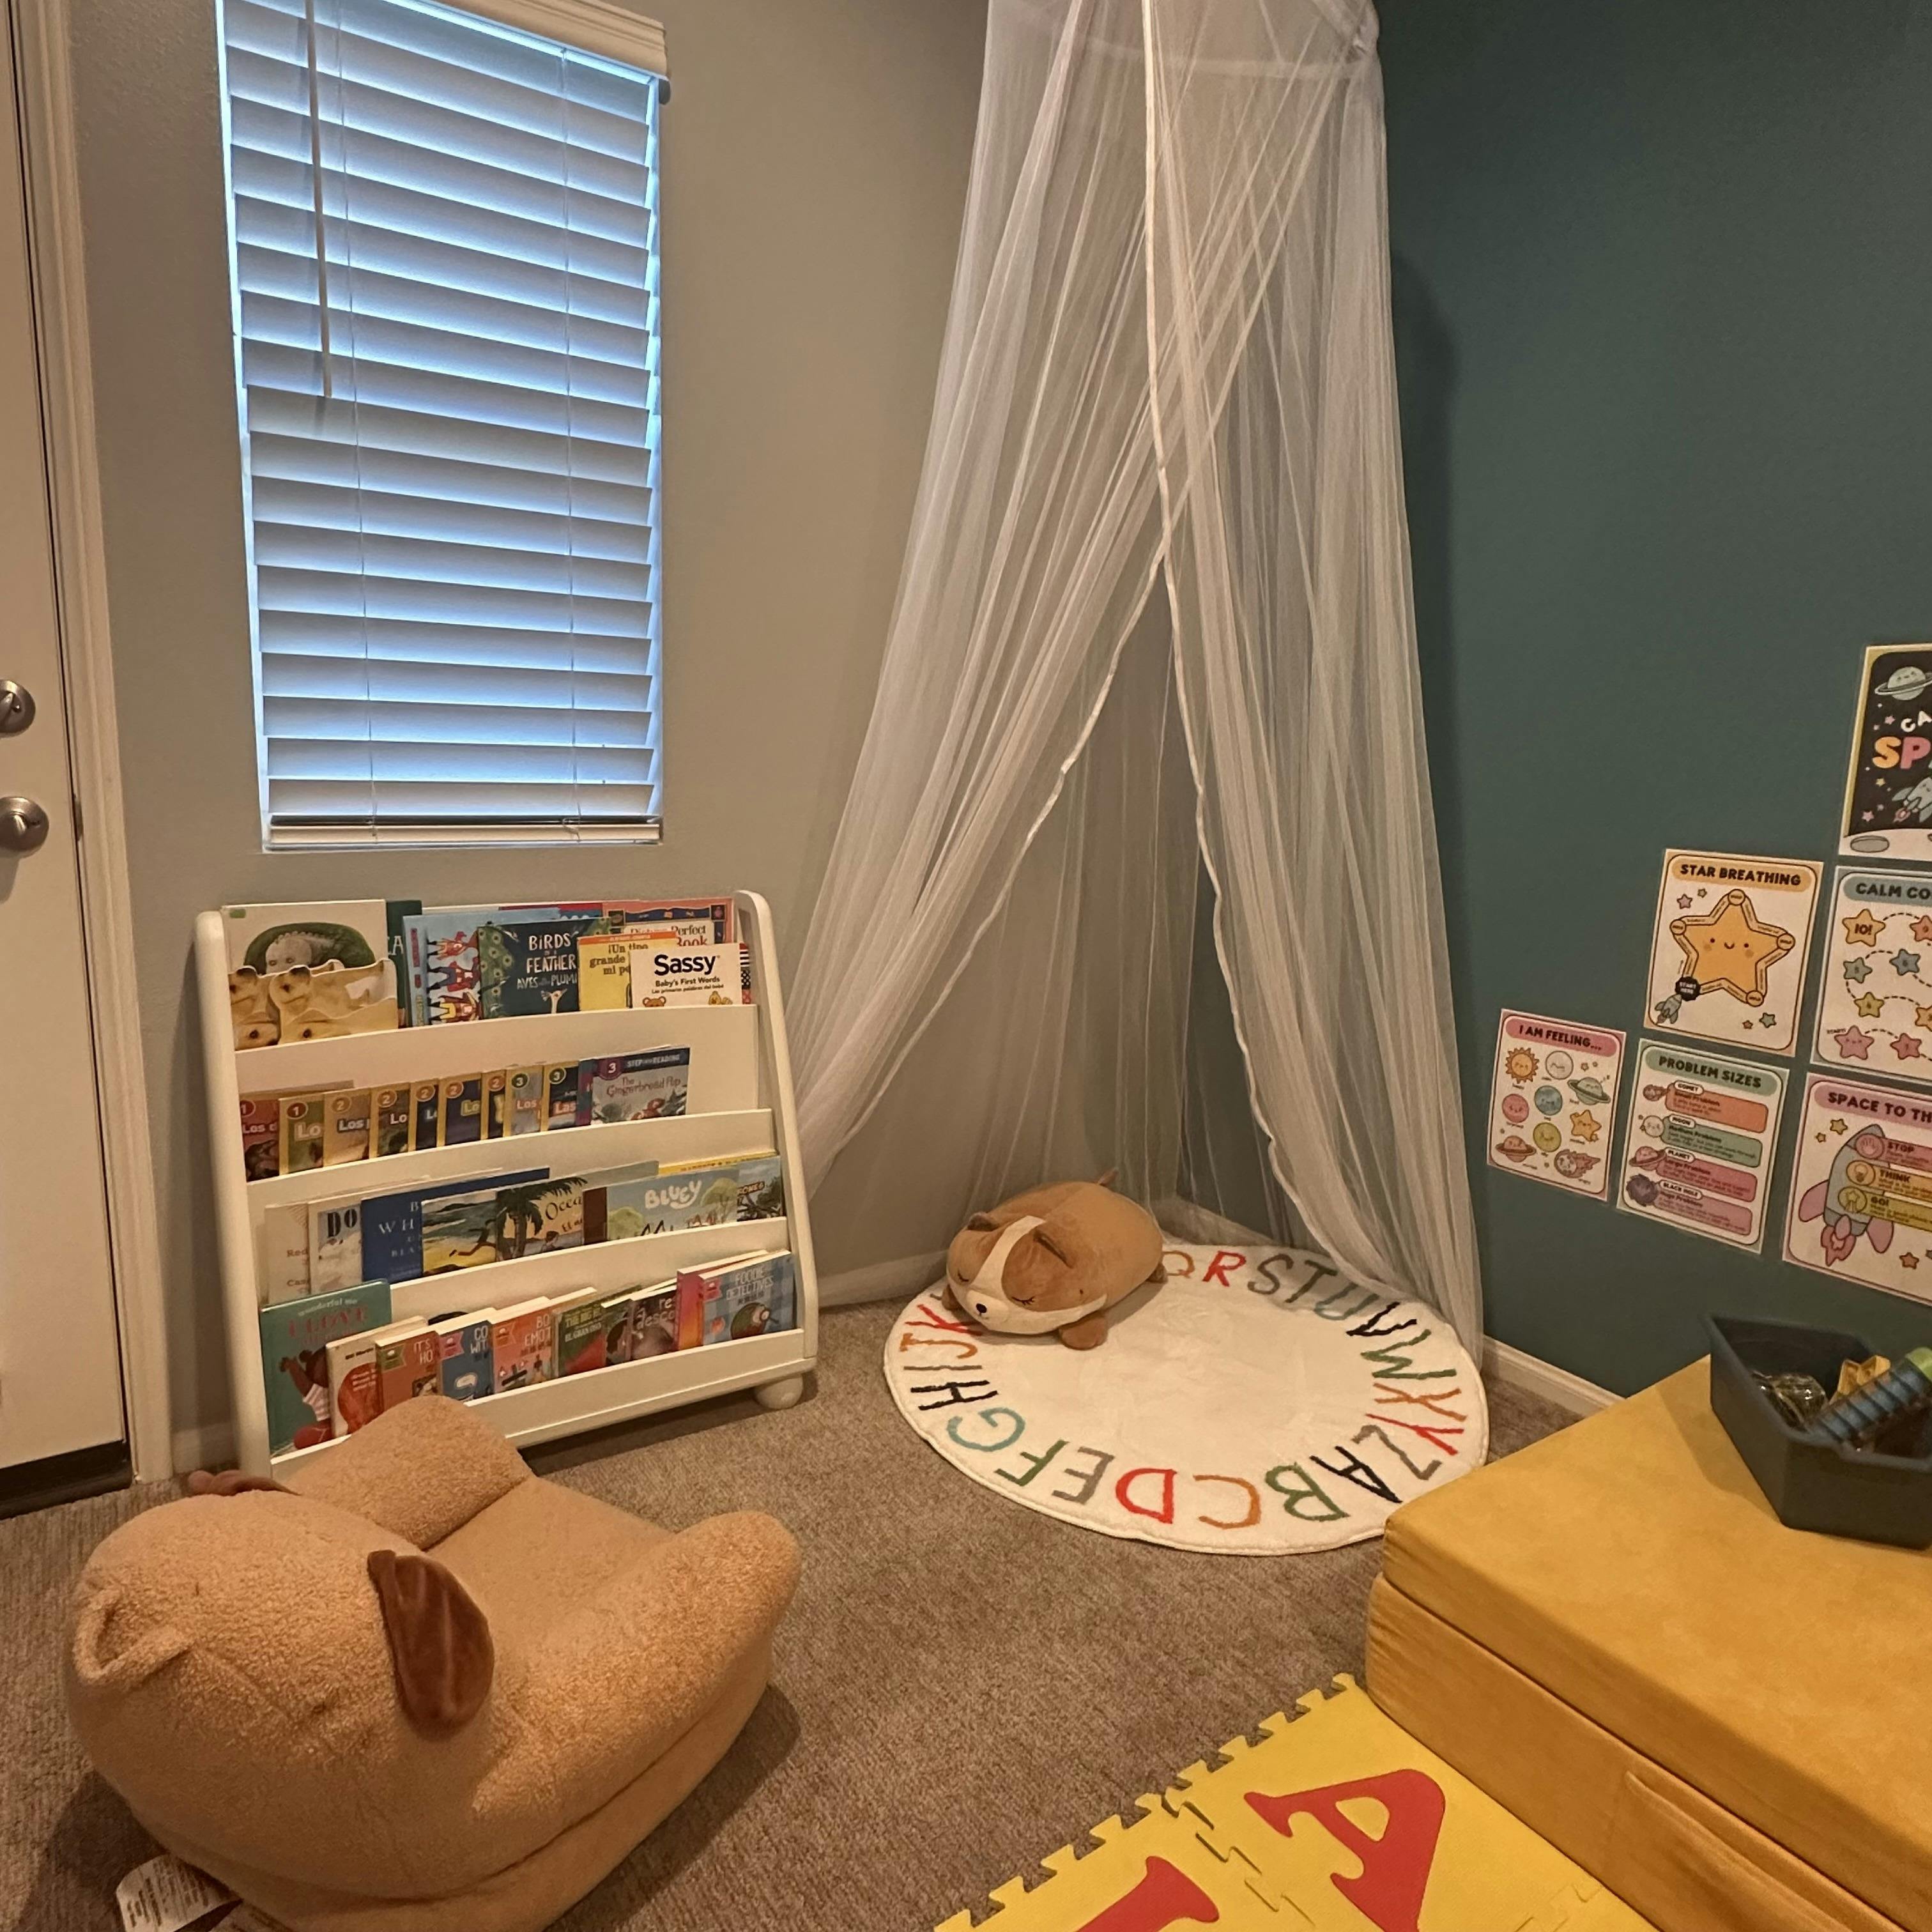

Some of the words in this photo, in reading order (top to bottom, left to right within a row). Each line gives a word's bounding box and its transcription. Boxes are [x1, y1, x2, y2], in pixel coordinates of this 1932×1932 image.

[1871, 736, 1932, 769] SP
[1680, 864, 1715, 878] STAR
[1719, 868, 1802, 887] BREATHING
[1855, 883, 1902, 898] CALM
[1906, 887, 1931, 900] CO
[671, 924, 706, 937] Perfect
[526, 954, 576, 974] FEATHER
[590, 954, 625, 968] grande
[654, 954, 716, 976] Sassy
[603, 965, 617, 975] mi
[517, 977, 539, 990] AVES
[656, 979, 678, 987] Baby's
[1519, 1025, 1524, 1035] I
[1526, 1027, 1544, 1039] AM
[553, 1071, 561, 1081] 3
[608, 1062, 617, 1073] 3
[1659, 1055, 1720, 1079] PROBLEM
[1722, 1070, 1762, 1089] SIZES
[493, 1078, 500, 1088] 2
[516, 1077, 523, 1087] 3
[1677, 1082, 1699, 1092] COMET
[383, 1094, 391, 1105] 2
[421, 1089, 429, 1099] 2
[450, 1086, 457, 1096] 2
[293, 1106, 300, 1116] 1
[337, 1100, 345, 1111] 2
[516, 1099, 537, 1110] Los
[555, 1101, 576, 1114] Las
[1827, 1091, 1880, 1112] SPACE
[1885, 1103, 1906, 1117] TO
[339, 1119, 364, 1131] Los
[390, 1113, 408, 1124] Lo
[1671, 1117, 1691, 1126] MOON
[243, 1124, 265, 1133] Los
[1667, 1149, 1691, 1161] PLANET
[1887, 1142, 1915, 1153] STOP
[1880, 1170, 1911, 1183] THINK
[645, 1180, 702, 1209] BLUEY
[1662, 1182, 1682, 1192] BLACK
[326, 1208, 358, 1238] DO
[1202, 1250, 1246, 1288] R
[1247, 1253, 1294, 1296] S
[1284, 1259, 1338, 1303] T
[1313, 1282, 1380, 1321] U
[905, 1303, 983, 1337] K
[1346, 1301, 1417, 1337] V
[899, 1332, 978, 1360] J
[1360, 1328, 1457, 1380] W
[419, 1349, 433, 1365] HO
[903, 1361, 983, 1371] I
[910, 1379, 999, 1411] H
[1373, 1382, 1468, 1422] X
[946, 1407, 1026, 1452] G
[1365, 1413, 1465, 1456] Y
[1349, 1424, 1443, 1480] Z
[993, 1439, 1070, 1487] F
[1051, 1446, 1115, 1505] E
[1309, 1445, 1404, 1504] A
[1115, 1468, 1177, 1524] D
[1264, 1461, 1350, 1522] B
[1192, 1475, 1262, 1529] C
[1243, 1768, 1446, 1932] A
